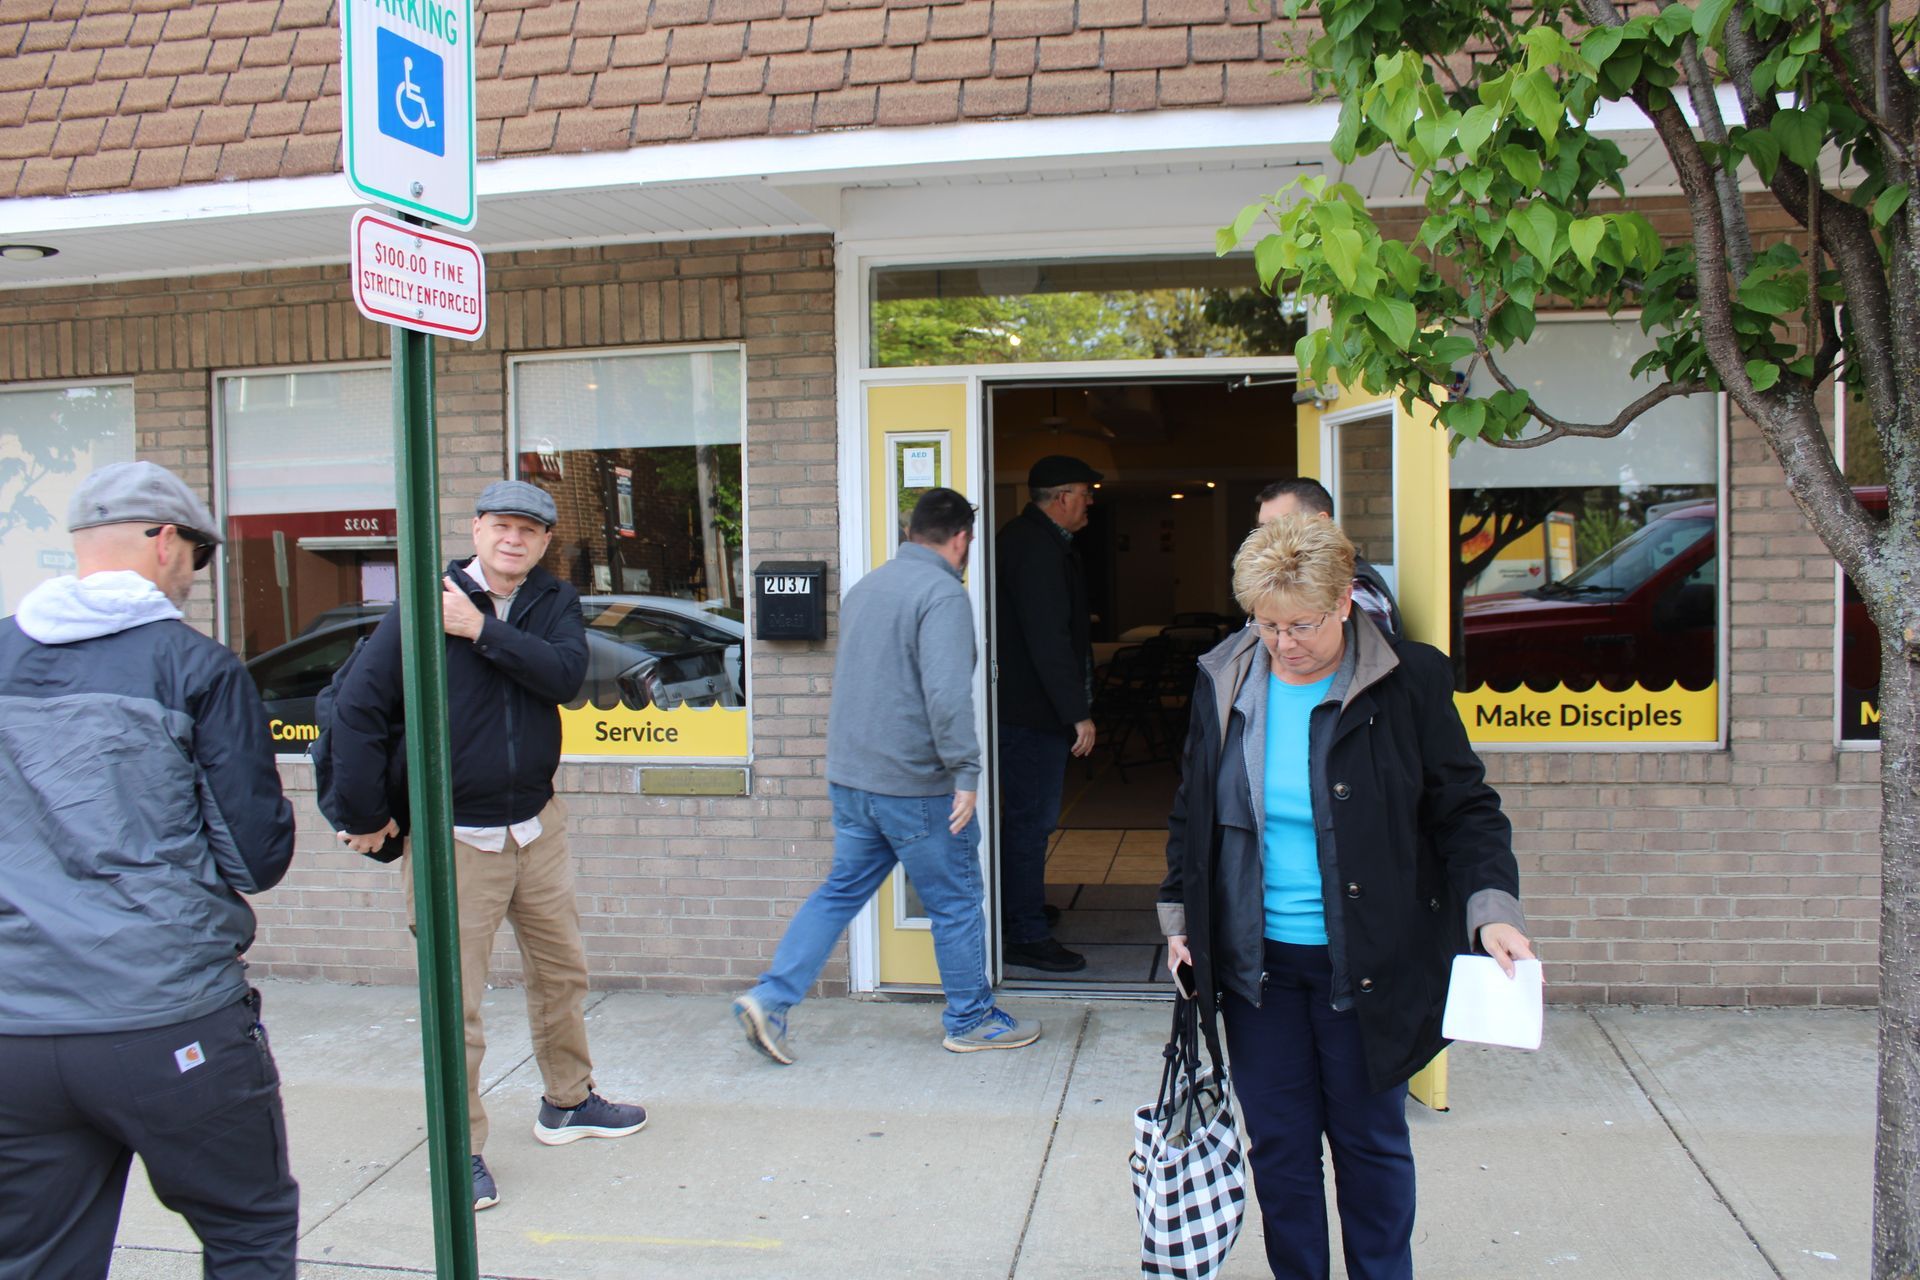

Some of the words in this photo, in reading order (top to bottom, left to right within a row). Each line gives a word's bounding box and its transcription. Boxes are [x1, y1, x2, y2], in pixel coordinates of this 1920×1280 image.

[364, 0, 457, 45] RKING
[375, 242, 427, 275] $100.00
[434, 261, 464, 284] FINE
[364, 270, 414, 301] STRICTLY
[417, 286, 477, 314] ENFORCED
[766, 577, 808, 592] 2037
[595, 721, 678, 742] Service
[1476, 704, 1551, 726] Make
[1560, 703, 1682, 731] Disciples
